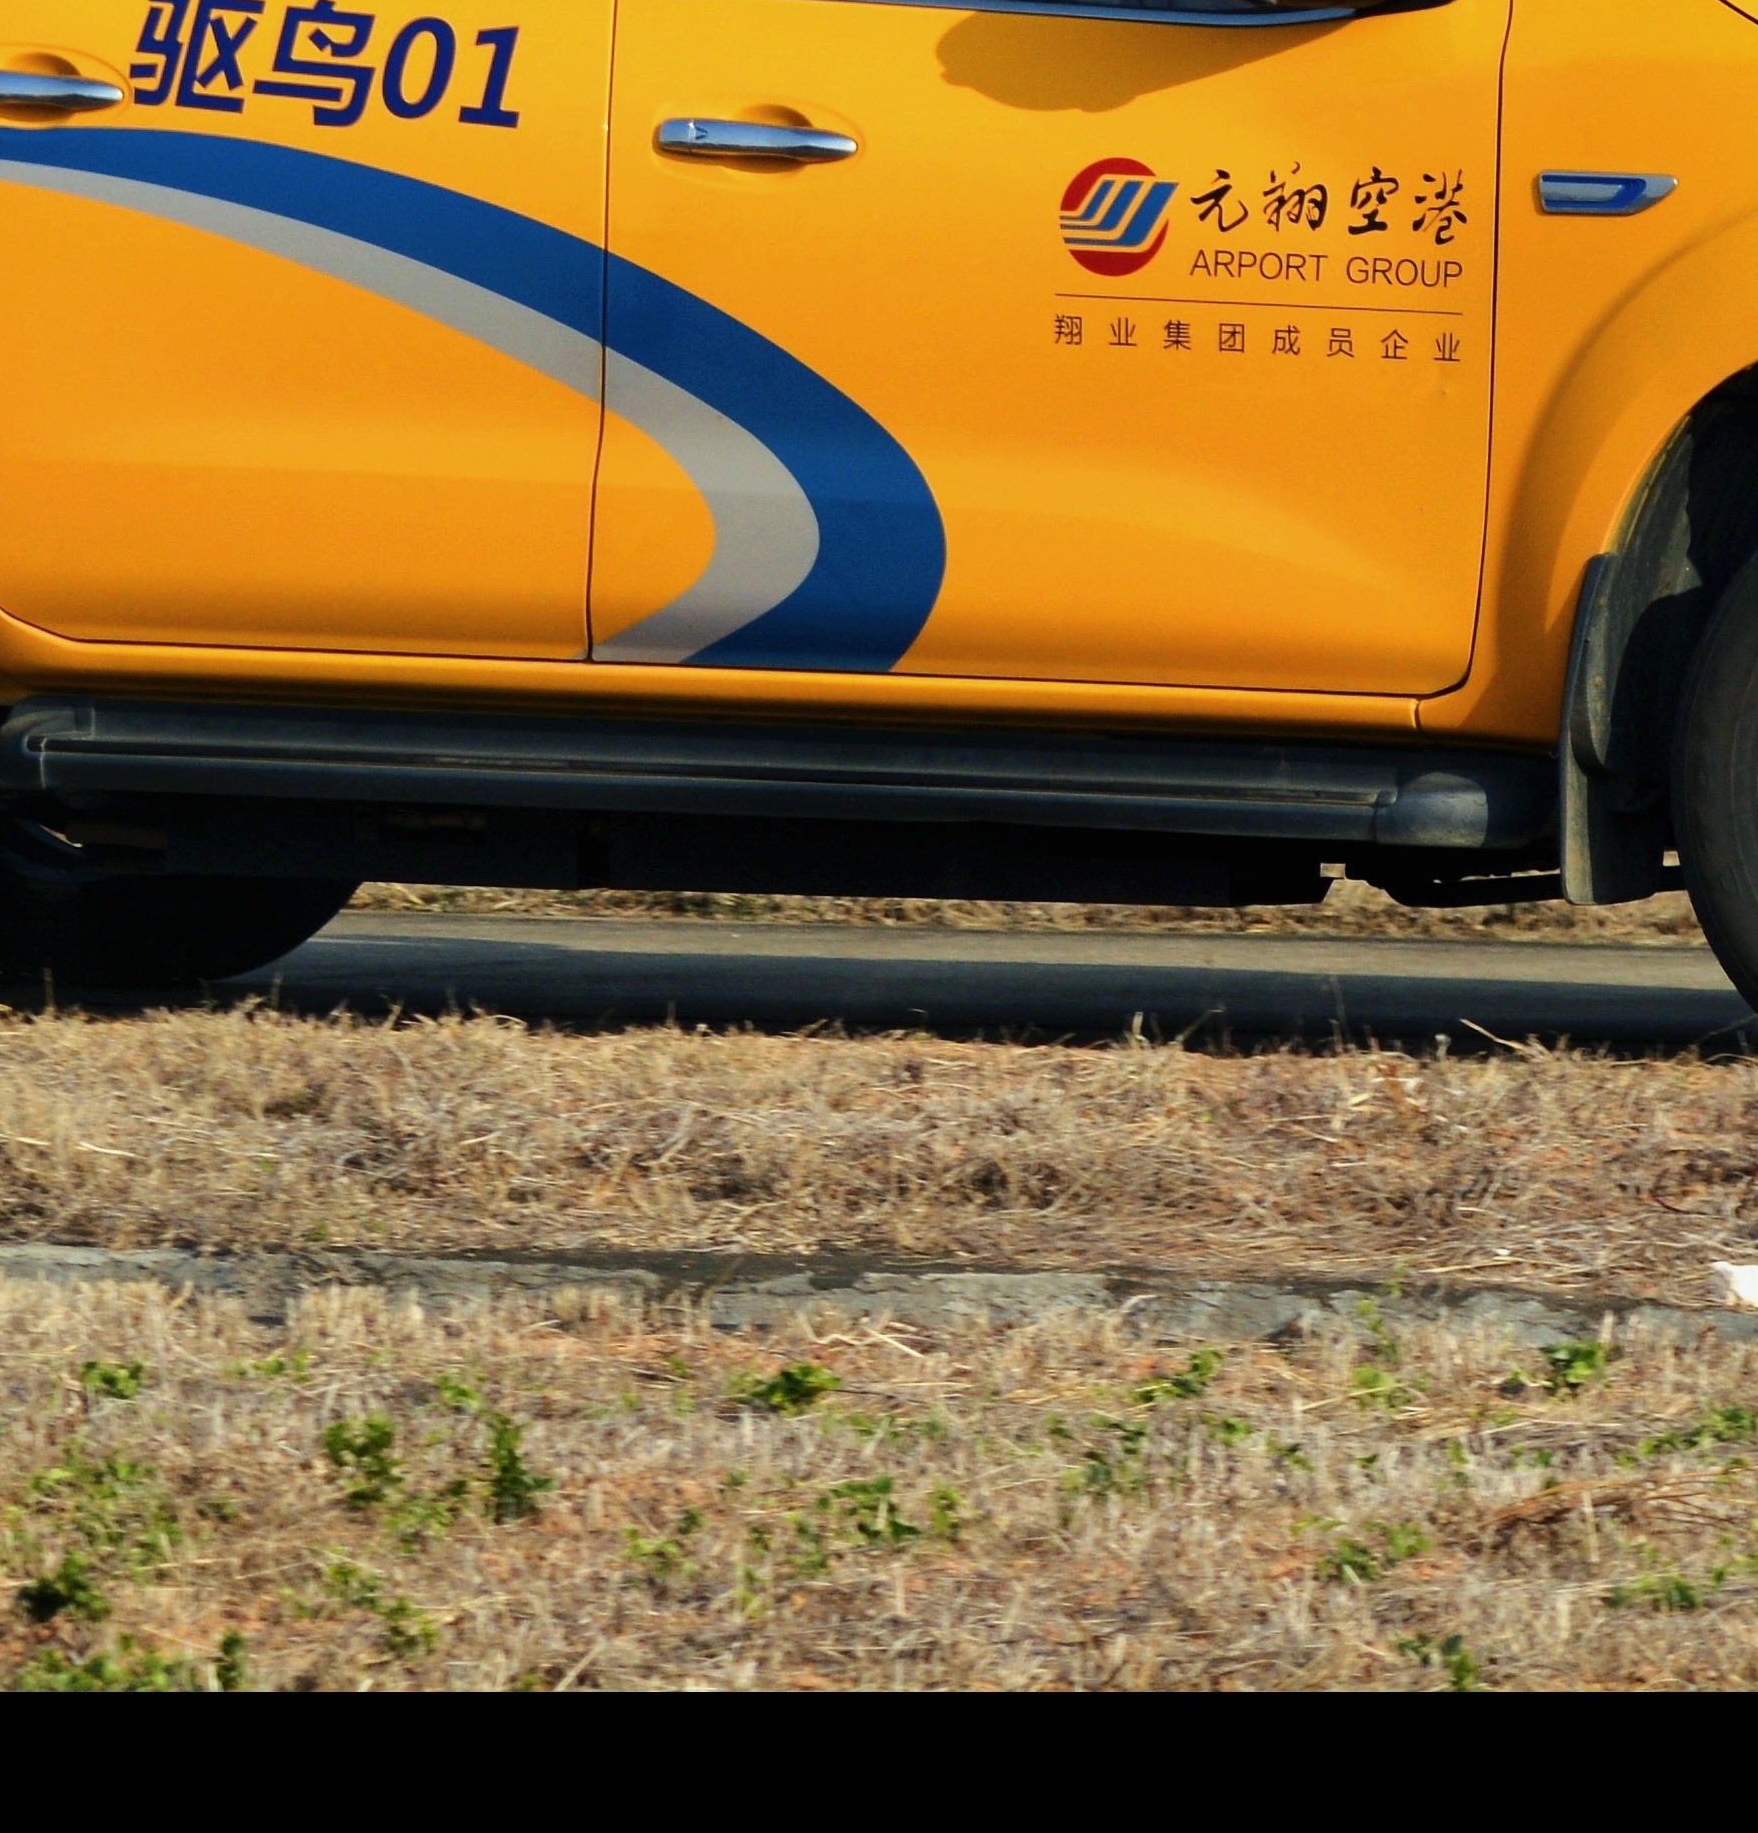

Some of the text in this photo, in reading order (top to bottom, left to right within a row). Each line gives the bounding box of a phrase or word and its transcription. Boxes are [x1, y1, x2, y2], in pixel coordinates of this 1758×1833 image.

[1190, 161, 1468, 246] 元翔空港
[1190, 249, 1463, 288] ARPORT GROUP
[1054, 314, 1461, 362] 翔业集团成员企业
